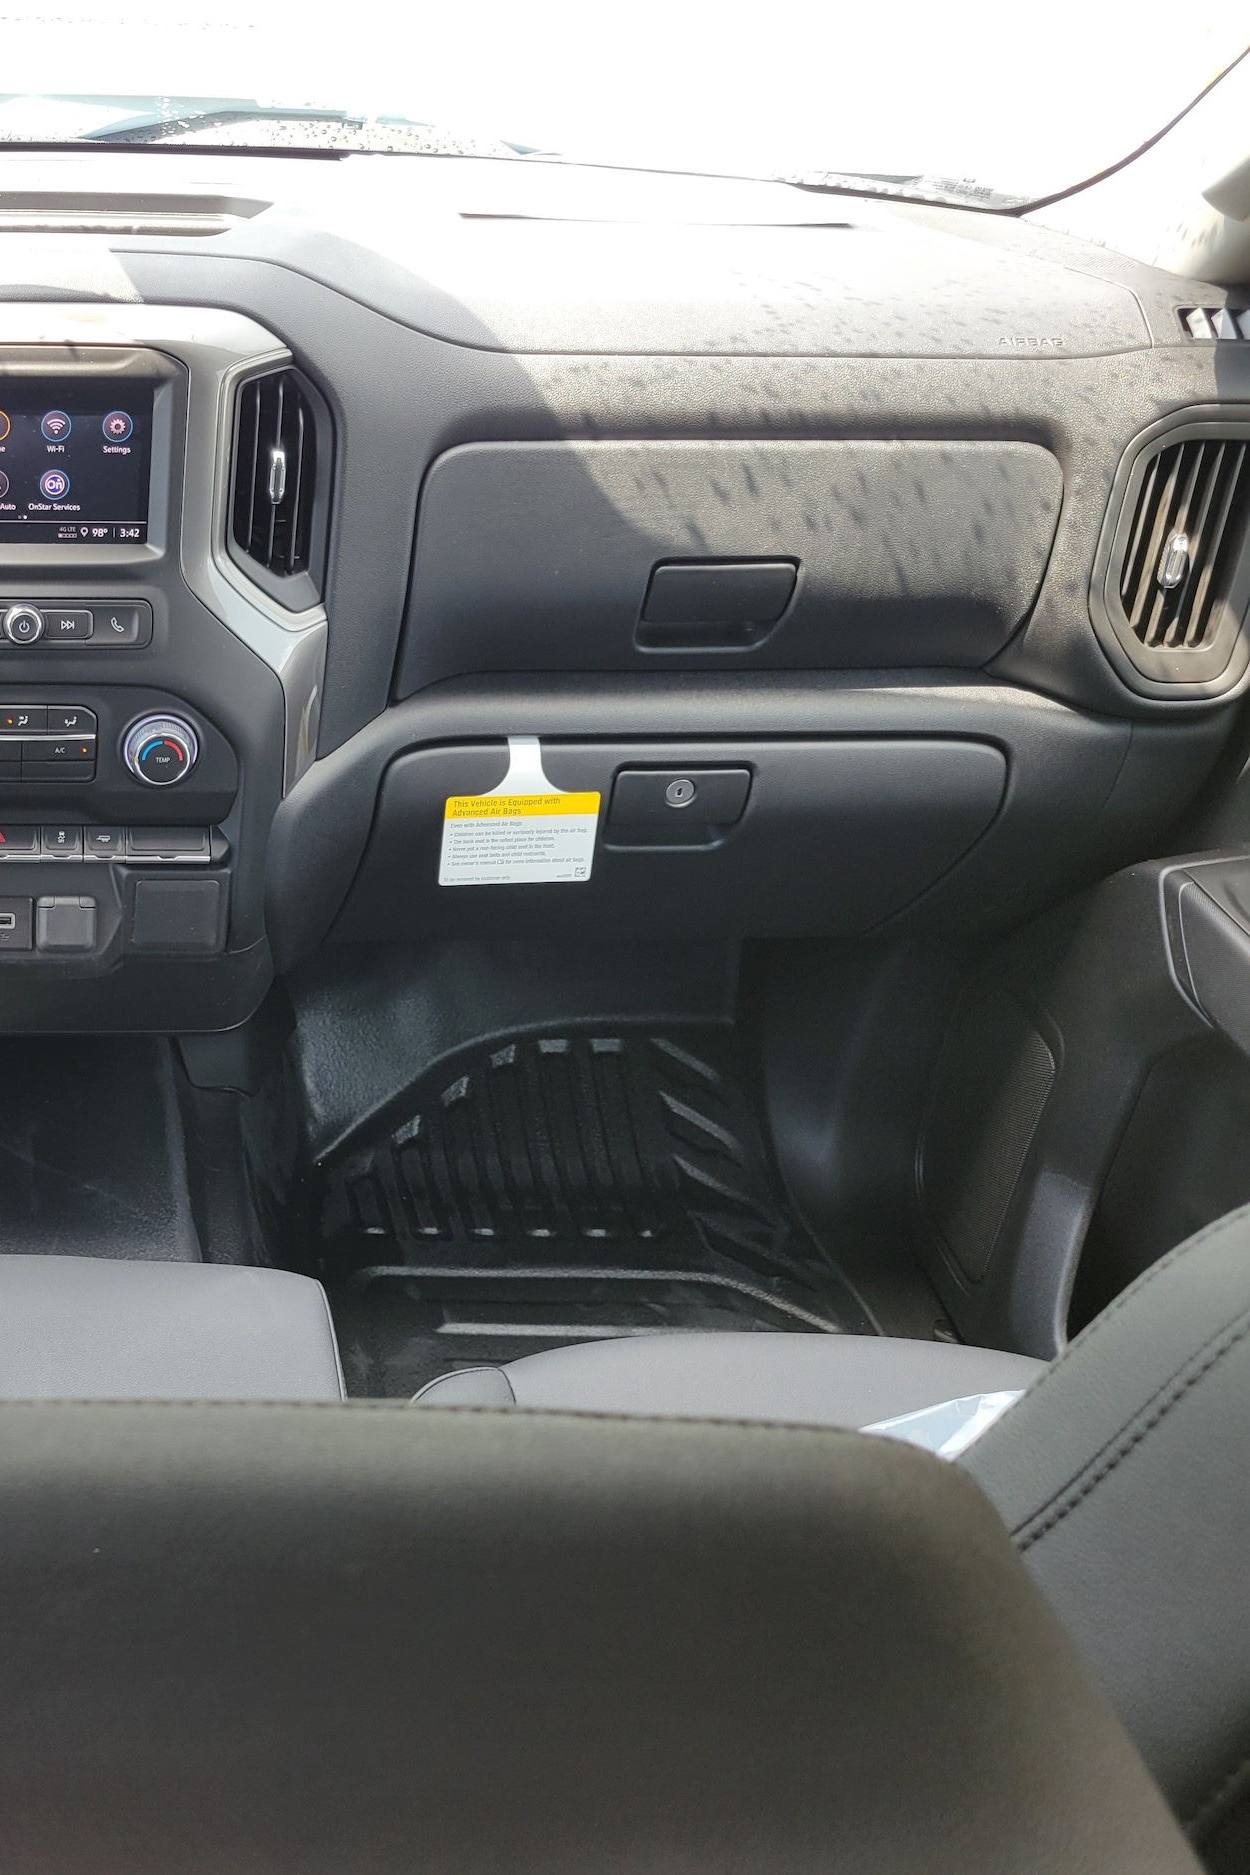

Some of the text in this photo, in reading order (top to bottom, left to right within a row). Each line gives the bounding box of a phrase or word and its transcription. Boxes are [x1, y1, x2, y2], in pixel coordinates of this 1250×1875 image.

[998, 337, 1064, 347] AIRBAG
[47, 445, 65, 453] Wi-Fi
[103, 446, 131, 455] Settings
[28, 503, 52, 511] OnStar
[119, 528, 140, 538] 3:42
[508, 798, 543, 807] Equipped
[544, 797, 561, 805] with
[453, 808, 489, 816] Advanced
